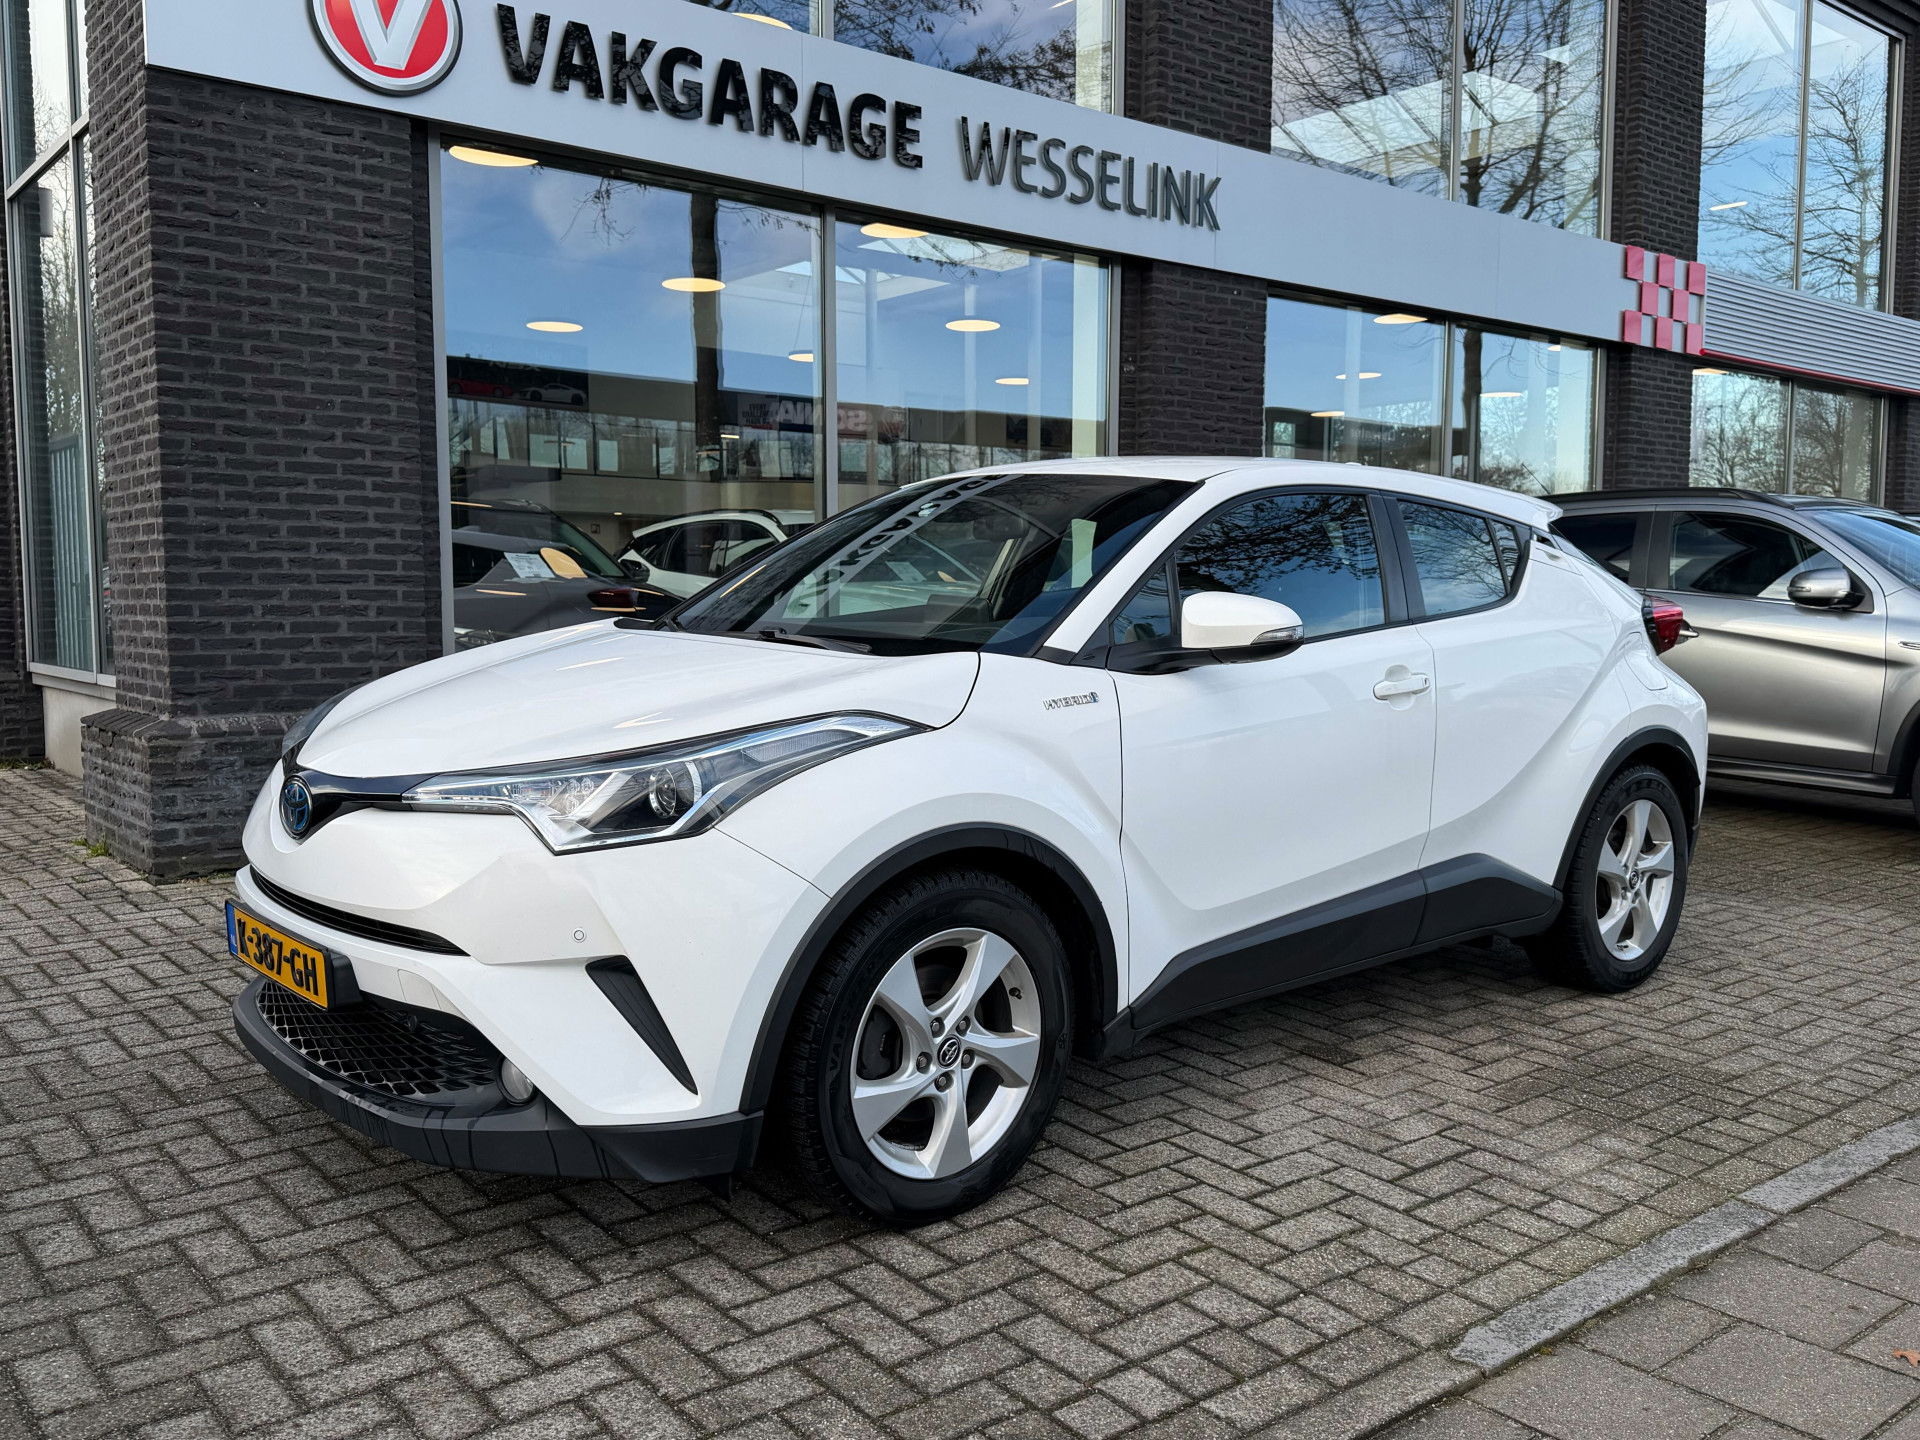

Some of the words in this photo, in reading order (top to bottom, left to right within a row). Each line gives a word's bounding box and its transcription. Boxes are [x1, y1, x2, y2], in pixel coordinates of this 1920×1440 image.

[349, 0, 434, 70] V
[496, 3, 924, 169] VAKGARAGE
[959, 115, 1223, 231] WESSELINK
[1042, 694, 1092, 711] HYBRID
[237, 918, 320, 997] K-387-GH
